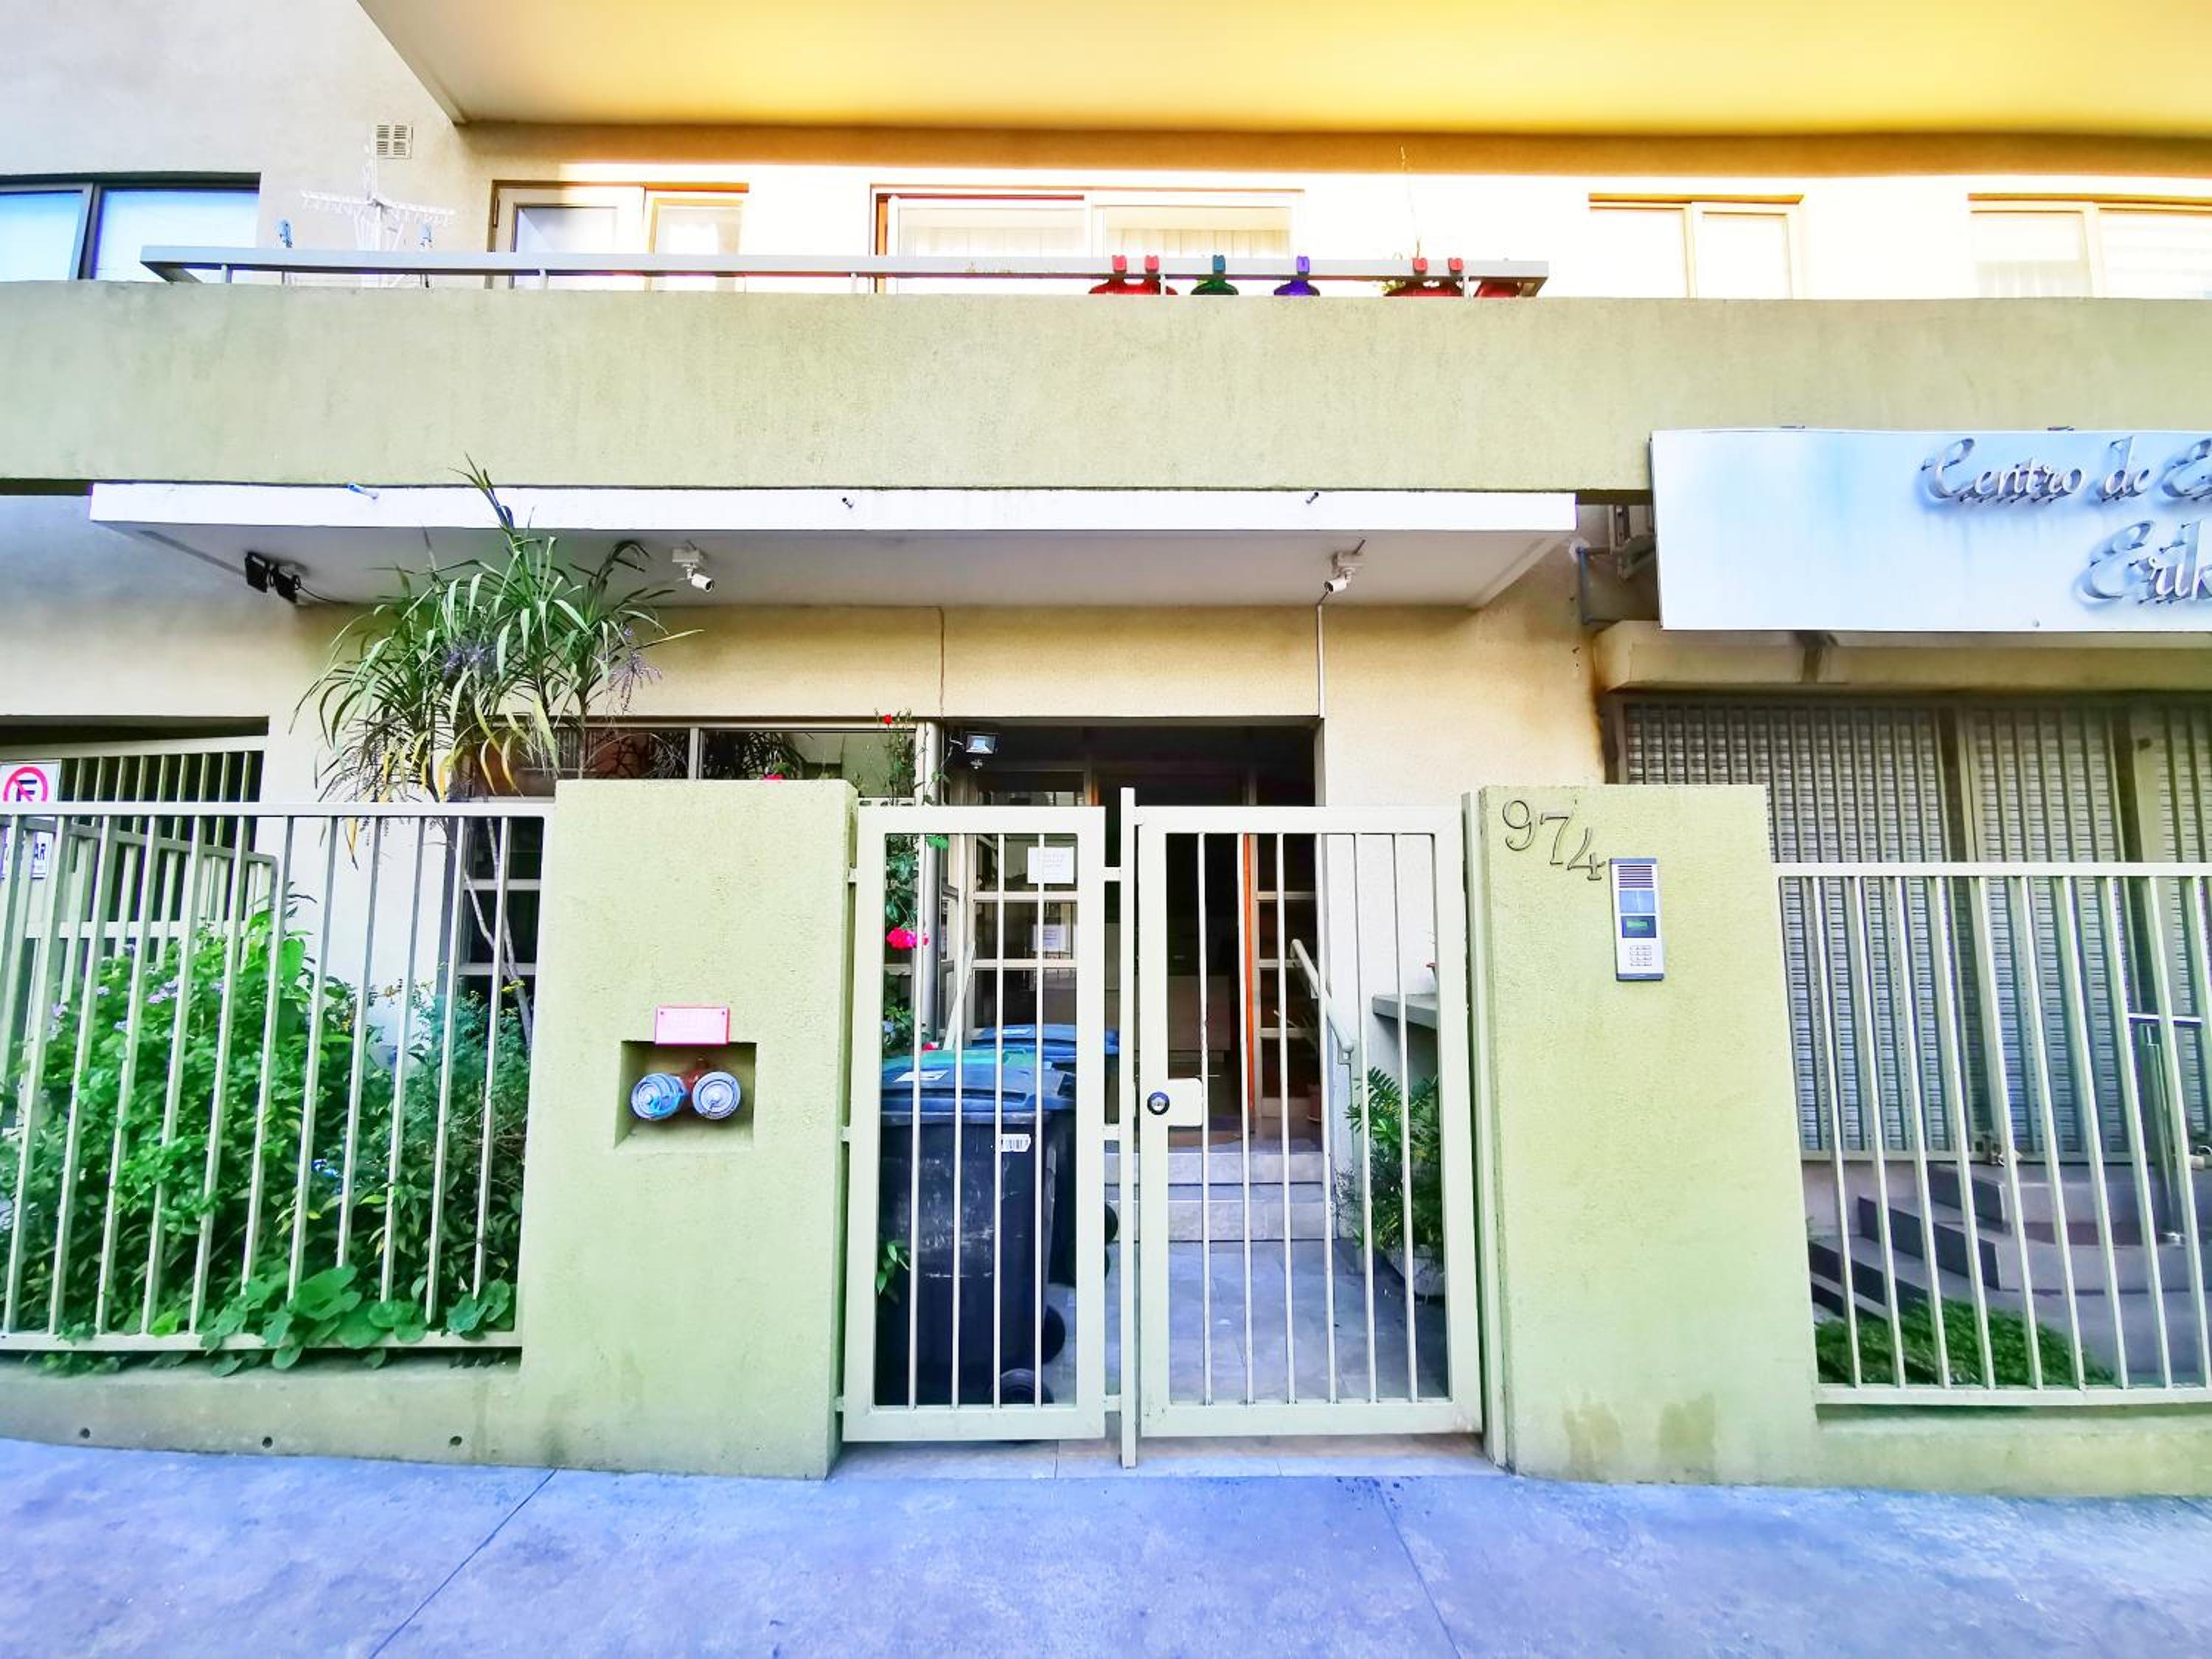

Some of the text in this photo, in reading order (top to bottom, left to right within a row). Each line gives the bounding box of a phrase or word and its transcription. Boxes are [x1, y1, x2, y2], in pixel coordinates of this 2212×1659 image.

[1921, 437, 2084, 500] Centro
[2098, 435, 2151, 499] de
[1502, 799, 1607, 881] 974
